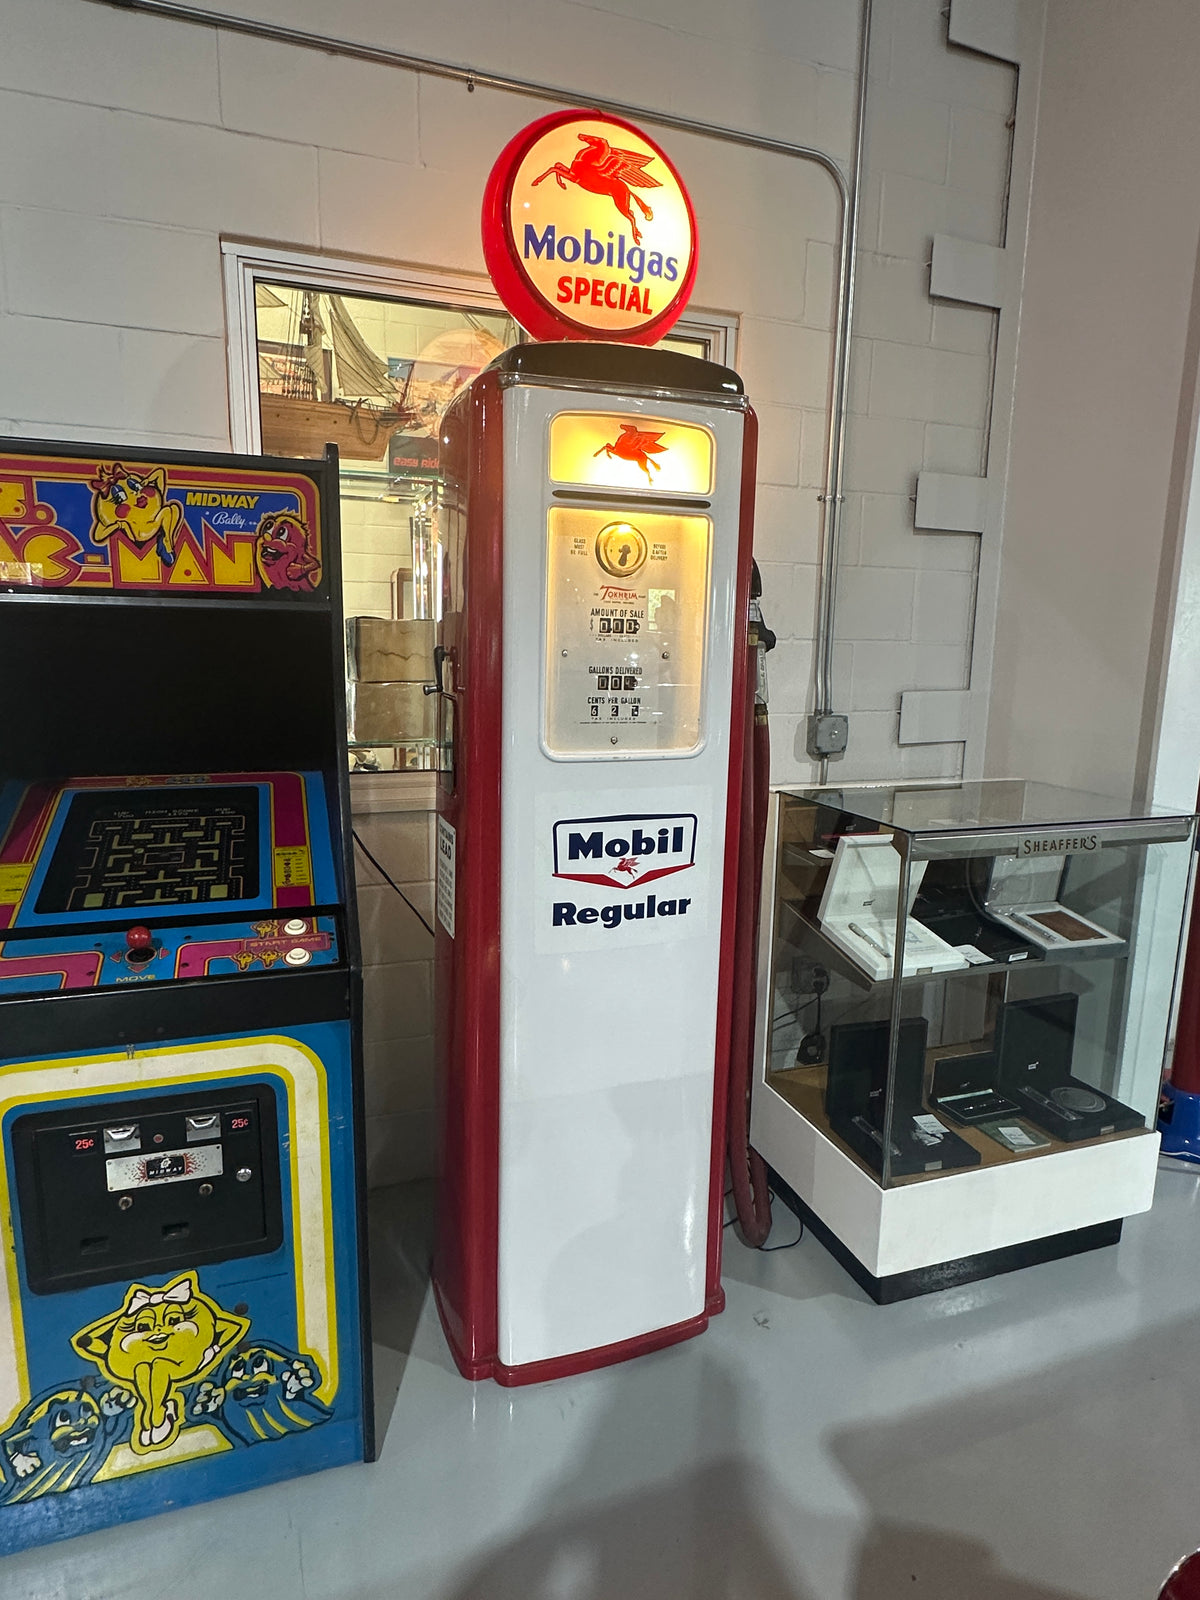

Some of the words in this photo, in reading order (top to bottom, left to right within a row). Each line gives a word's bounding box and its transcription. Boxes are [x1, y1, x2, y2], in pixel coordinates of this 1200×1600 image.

[524, 223, 678, 284] Mobilgas
[556, 275, 653, 315] SPECIAL
[185, 491, 260, 510] MIDWAY
[211, 511, 246, 528] Bally
[590, 608, 618, 617] AMOUNT
[619, 609, 628, 618] OF
[629, 609, 645, 619] SALE
[588, 666, 614, 675] GALLONS
[615, 666, 643, 675] DELIVERED
[587, 696, 605, 704] CENTS
[620, 697, 642, 705] GALLON
[568, 826, 684, 860] Mobil
[1023, 835, 1097, 855] SHEAFFER'S
[552, 895, 692, 929] Regular
[249, 940, 288, 948] START
[290, 936, 322, 944] GAME
[115, 974, 156, 983] MOVE
[231, 1118, 249, 1129] 25¢
[75, 1138, 95, 1150] 25¢
[148, 1165, 183, 1176] MIDWAY
